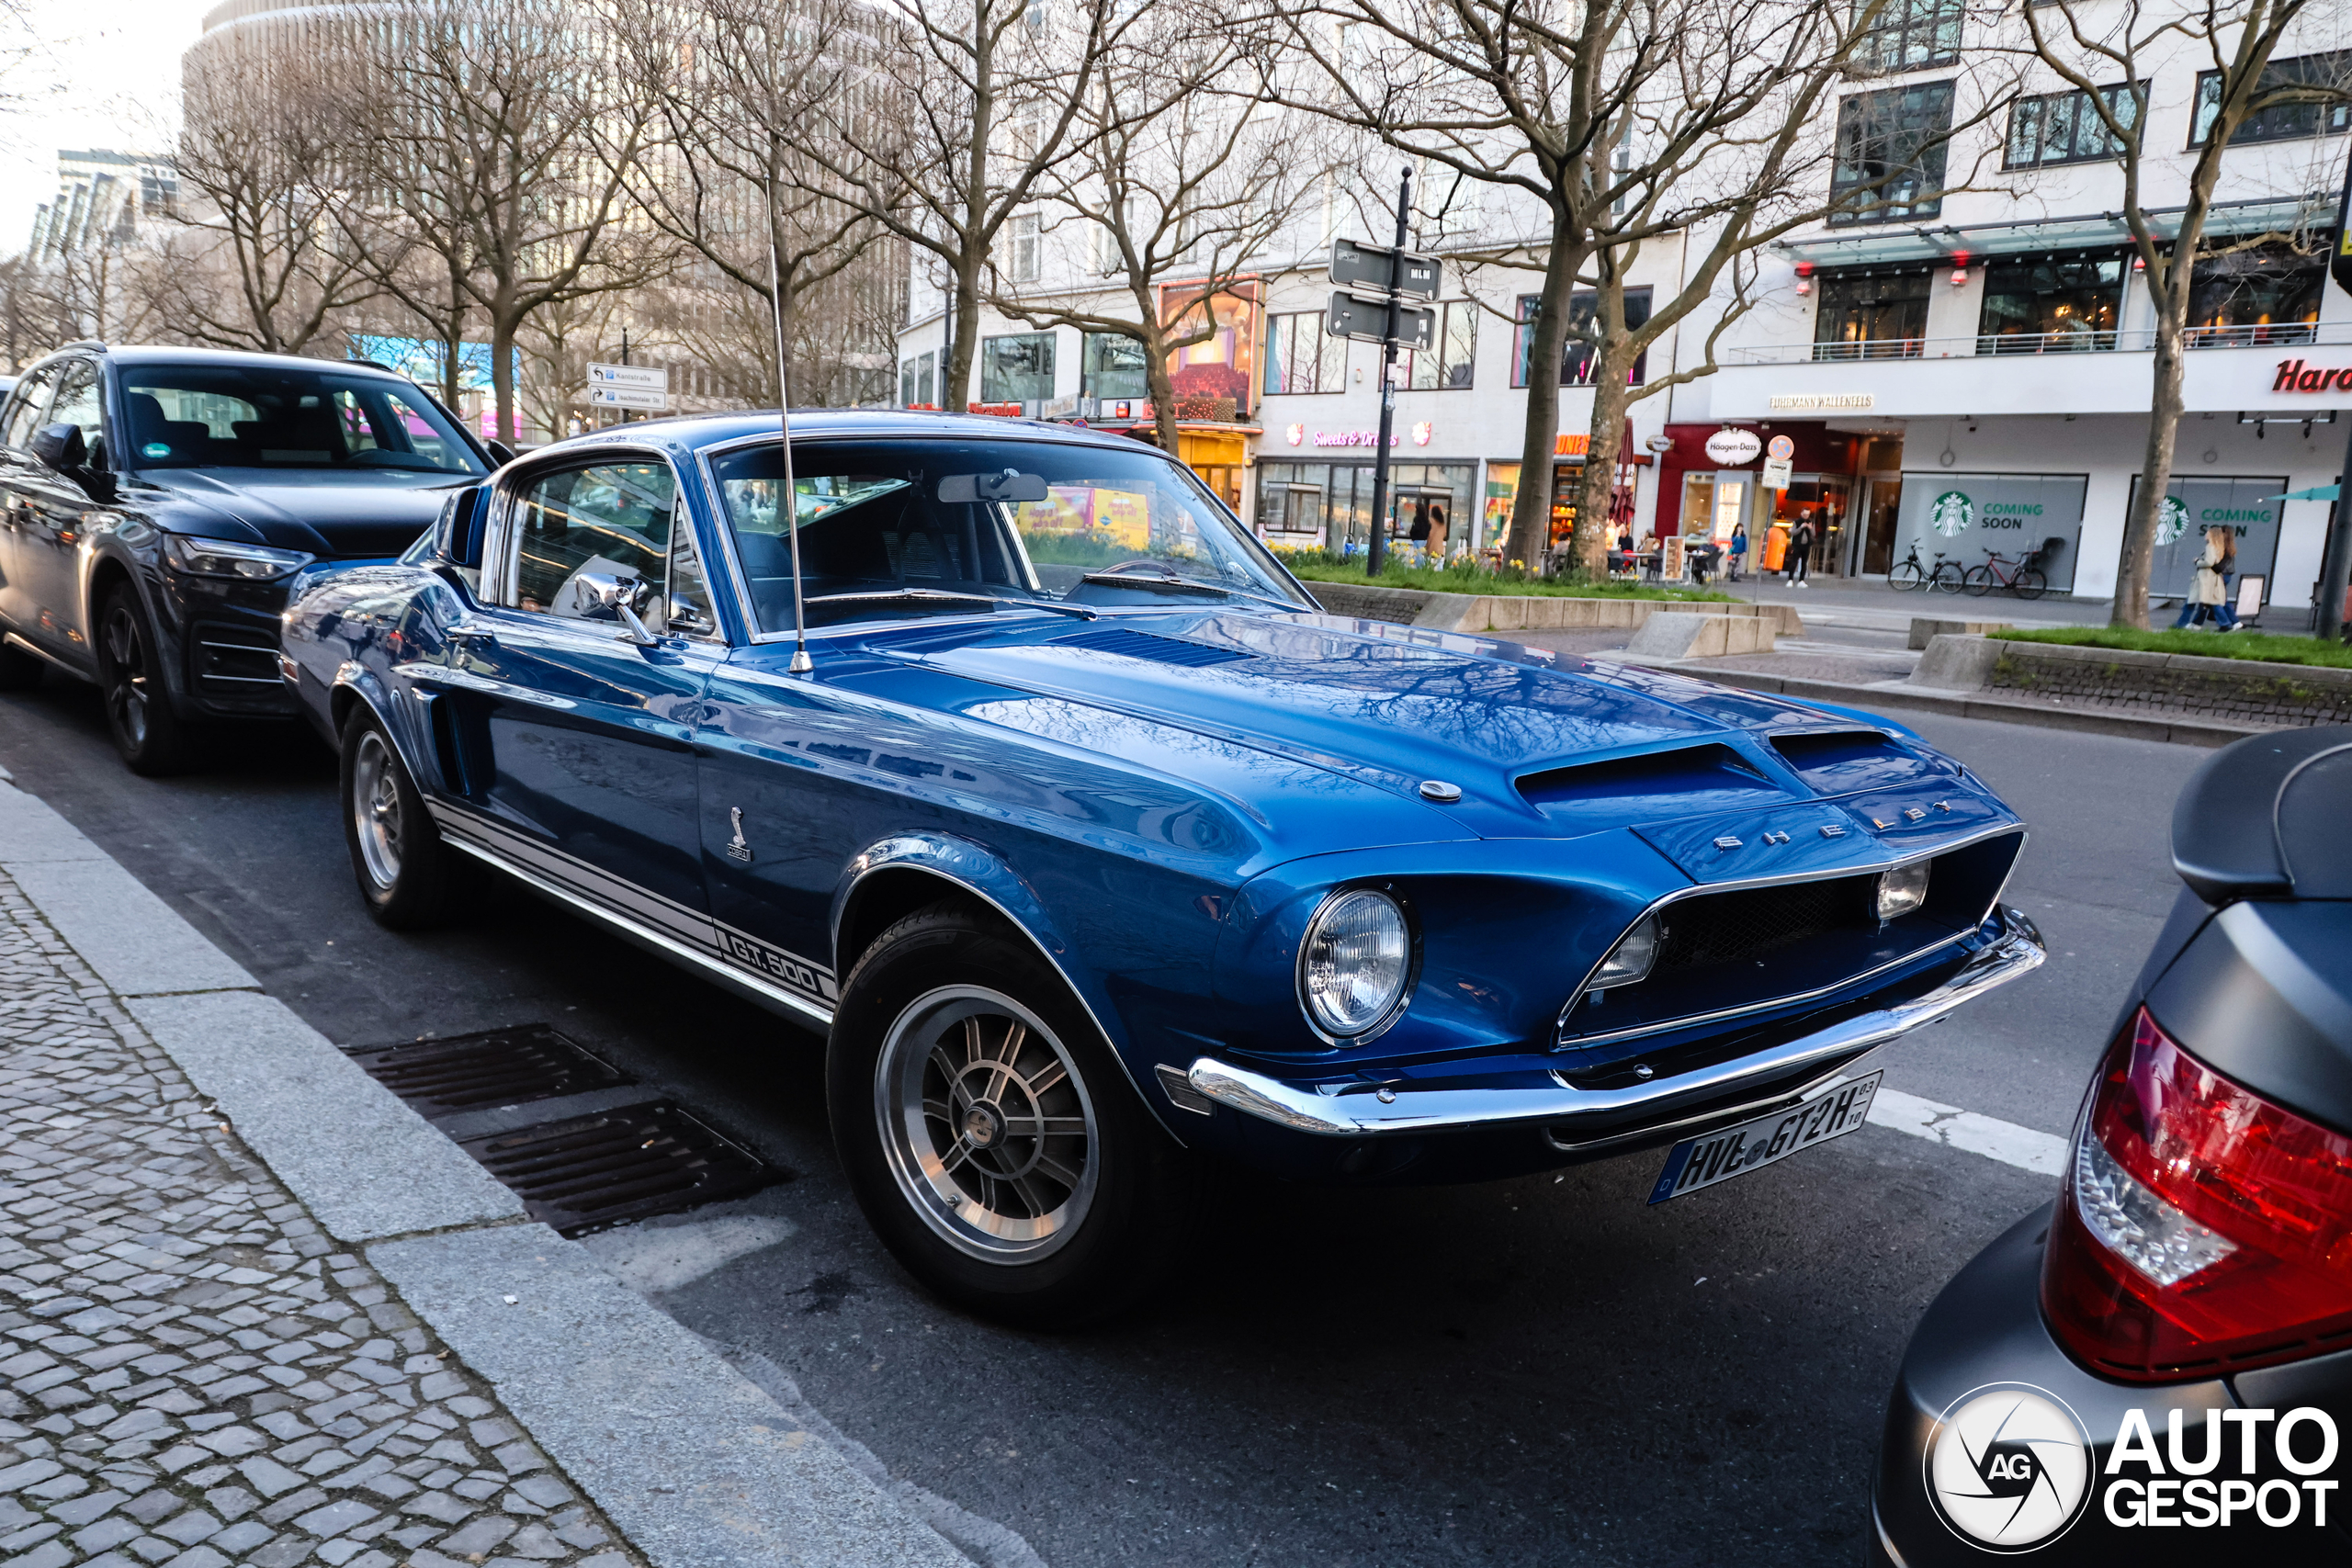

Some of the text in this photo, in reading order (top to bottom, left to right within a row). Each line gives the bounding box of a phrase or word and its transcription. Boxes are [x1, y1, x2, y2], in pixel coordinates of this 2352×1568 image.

[616, 372, 651, 382] Kantstraße
[1770, 394, 1872, 409] FUHRMANN WALLENFELS
[1313, 430, 1398, 446] Sweets & Dris
[1554, 434, 1591, 455] ONES
[1710, 442, 1757, 452] Häagen-Dazs
[1984, 502, 2043, 515] COMING
[2201, 508, 2272, 523] COMING
[1982, 517, 2022, 529] SOON
[2199, 524, 2247, 537] SN
[1713, 800, 1952, 851] SHELBY
[1859, 1080, 1875, 1096] 03
[1849, 1111, 1862, 1126] 10
[1659, 1179, 1671, 1191] D
